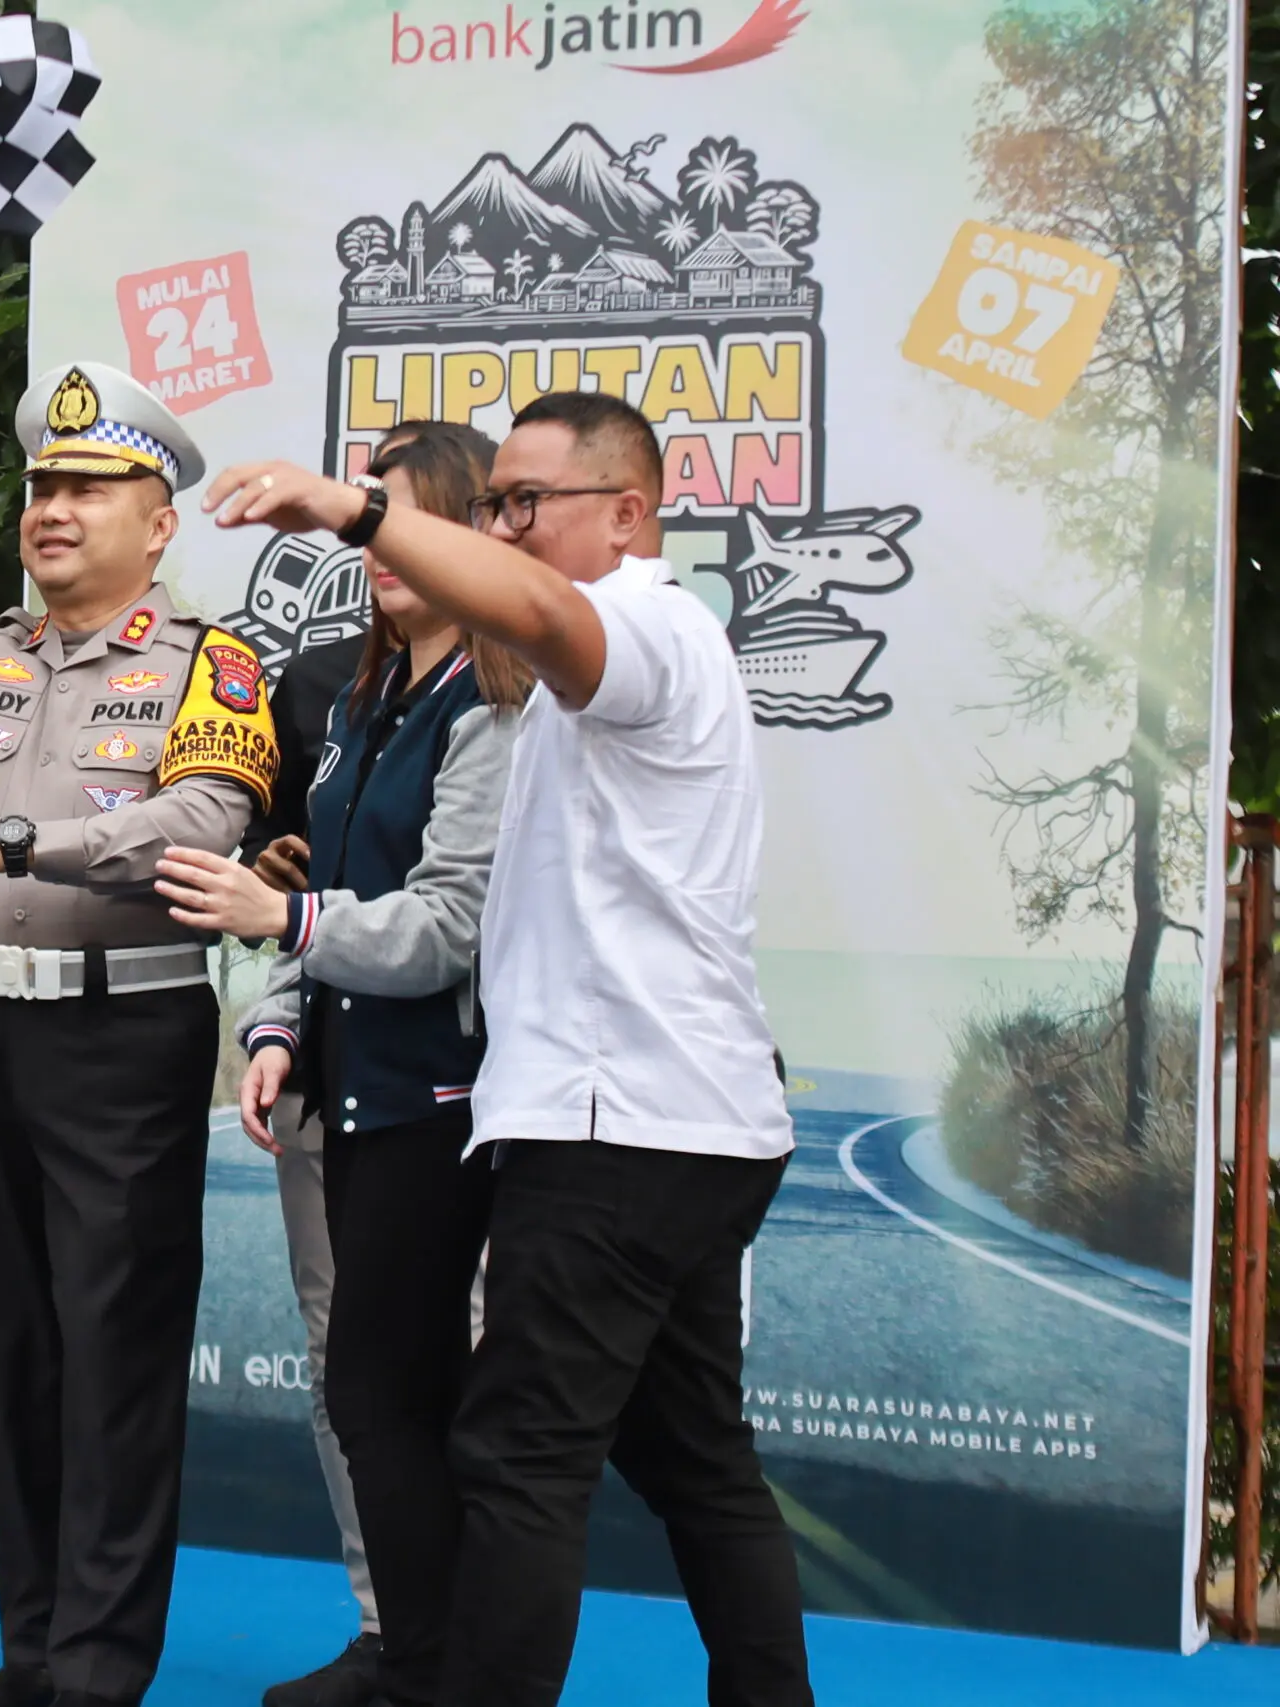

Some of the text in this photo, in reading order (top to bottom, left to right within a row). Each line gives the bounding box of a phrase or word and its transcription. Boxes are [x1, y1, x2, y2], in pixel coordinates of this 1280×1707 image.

[136, 264, 231, 310] MULAI
[970, 233, 1103, 296] SAMPAI
[146, 294, 239, 372] 24
[956, 267, 1075, 353] 07
[148, 356, 255, 401] MARET
[937, 333, 1042, 387] APRIL
[347, 341, 802, 430] LIPUTAN
[214, 650, 257, 673] POLDA
[91, 700, 164, 722] POLRI
[180, 752, 232, 764] KETUPAT
[742, 1411, 1097, 1460] RA SURABAYA MOBILE APPS
